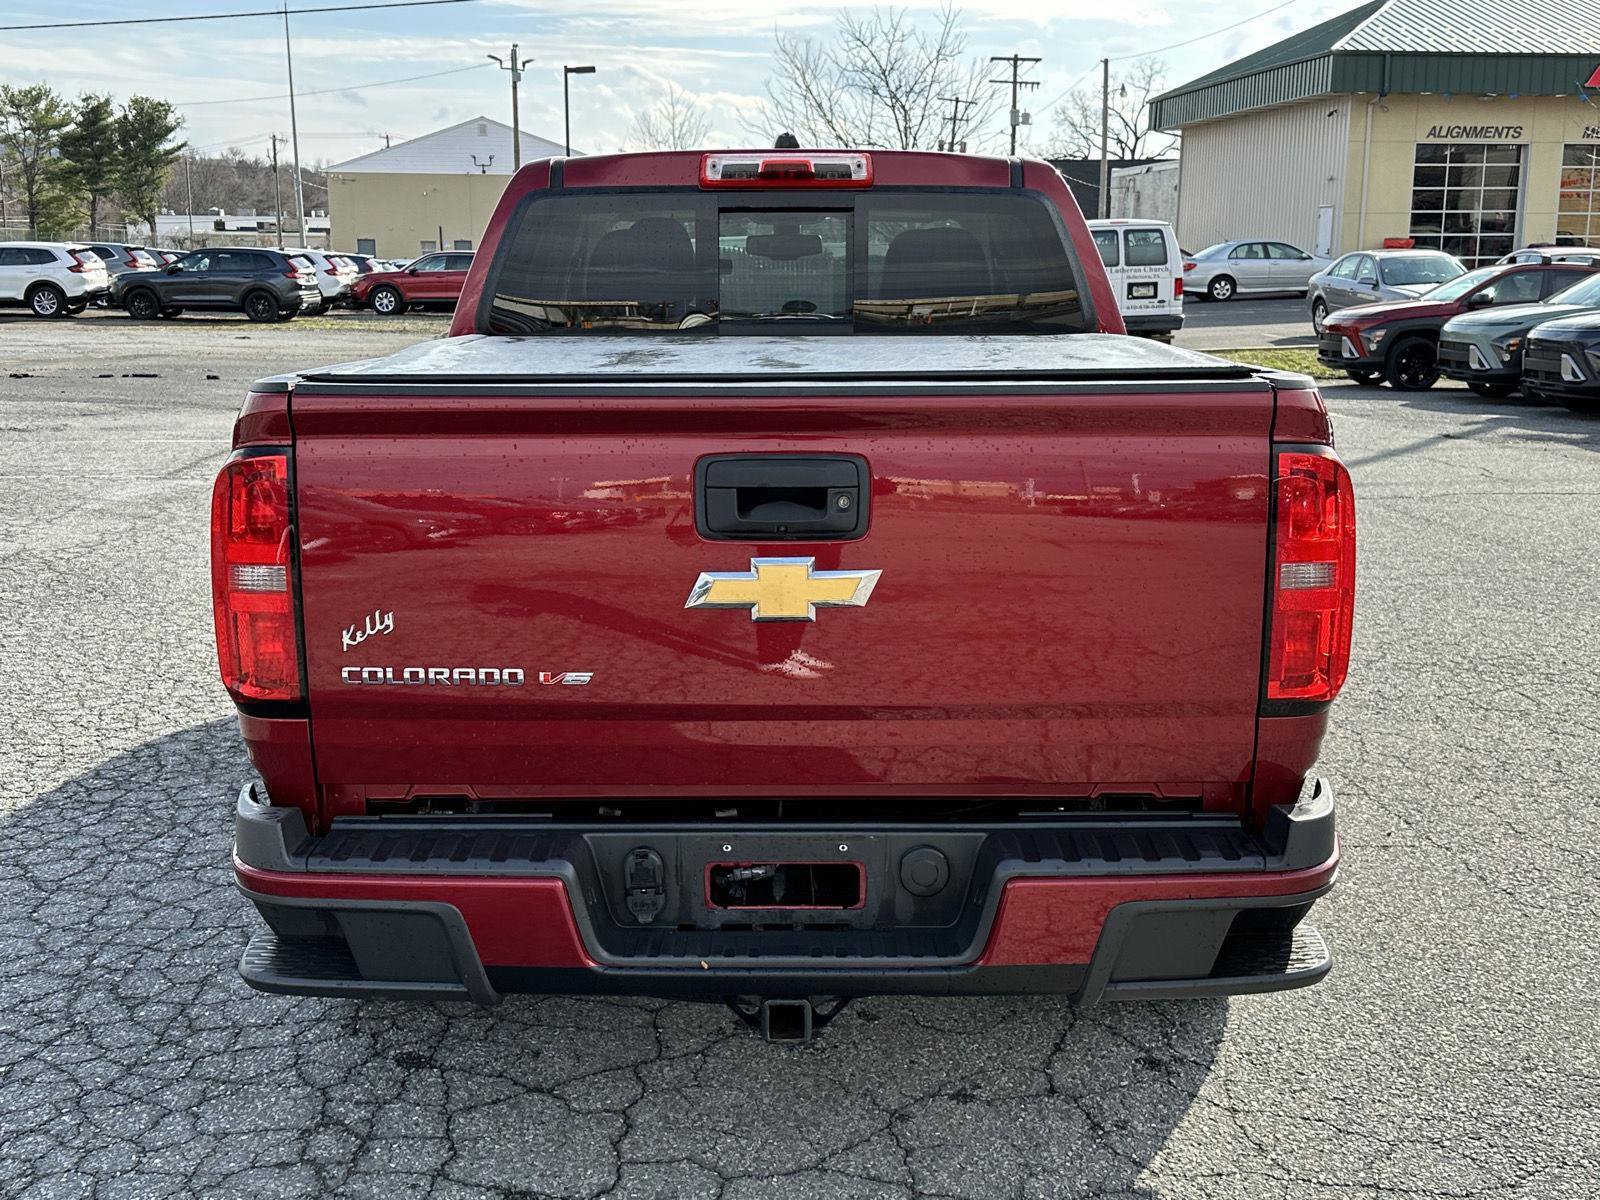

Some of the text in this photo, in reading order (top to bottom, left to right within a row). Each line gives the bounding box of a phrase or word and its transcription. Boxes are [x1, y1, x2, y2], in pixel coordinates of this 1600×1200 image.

[1426, 125, 1523, 139] ALIGNMENTS
[1143, 265, 1169, 273] Church
[341, 609, 395, 652] Kelly
[341, 666, 595, 686] COLORADO V6
